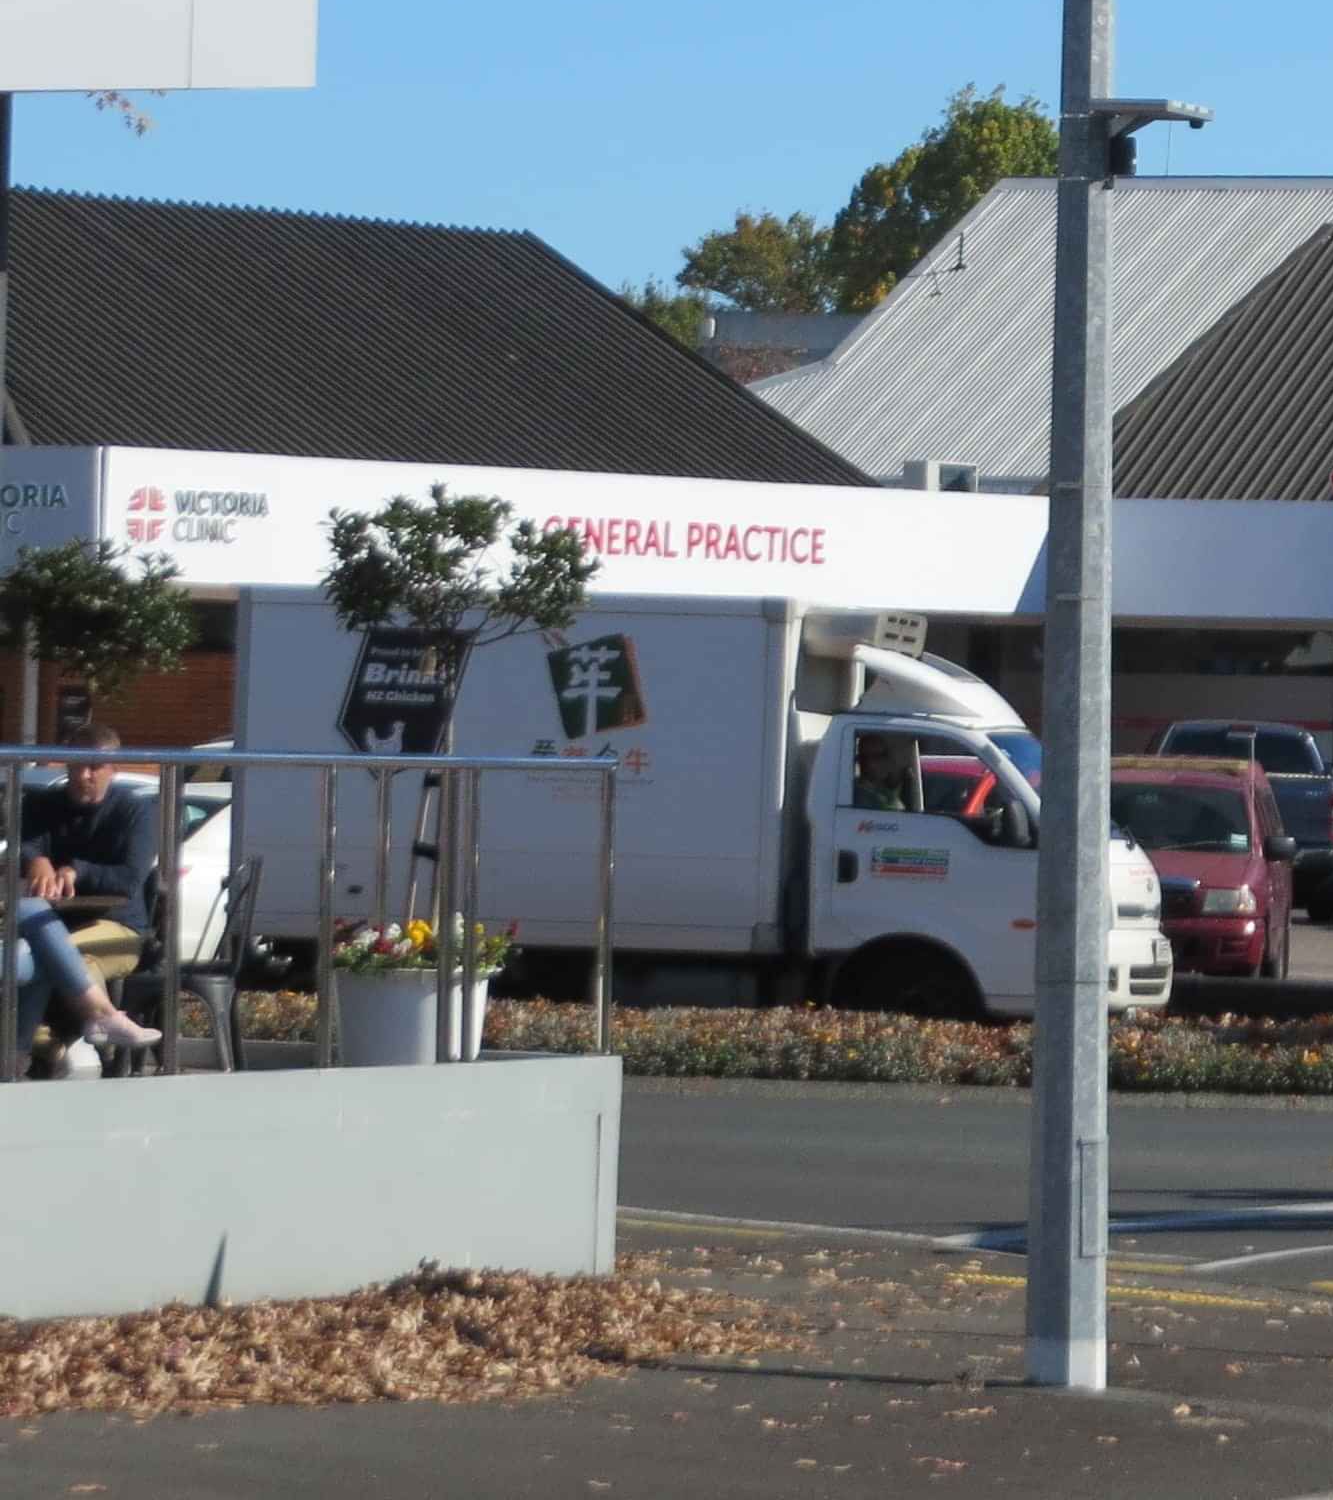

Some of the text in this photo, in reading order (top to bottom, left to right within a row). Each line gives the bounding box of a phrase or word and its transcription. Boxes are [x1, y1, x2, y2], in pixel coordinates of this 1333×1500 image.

[173, 489, 269, 518] VICTORIA
[172, 518, 239, 543] CLINIC
[686, 521, 826, 565] PRACTICE
